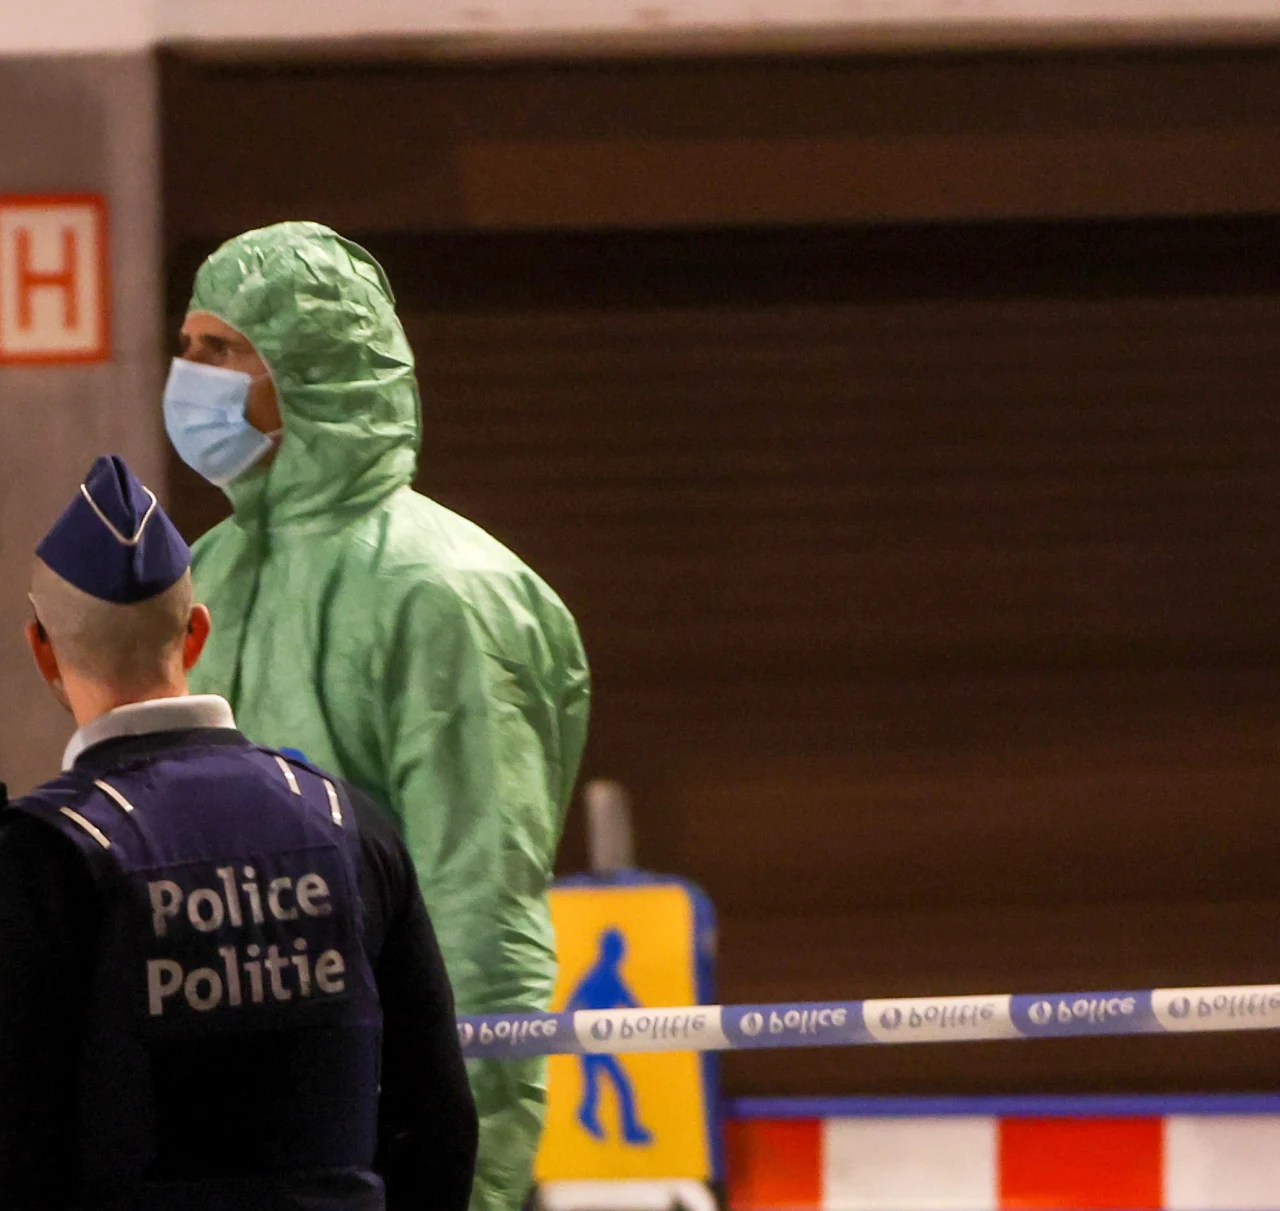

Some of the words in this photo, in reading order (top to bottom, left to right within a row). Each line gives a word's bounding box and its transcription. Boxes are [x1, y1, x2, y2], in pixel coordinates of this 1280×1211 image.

[15, 227, 77, 332] H
[147, 866, 333, 937] Police
[146, 938, 345, 1016] Politie
